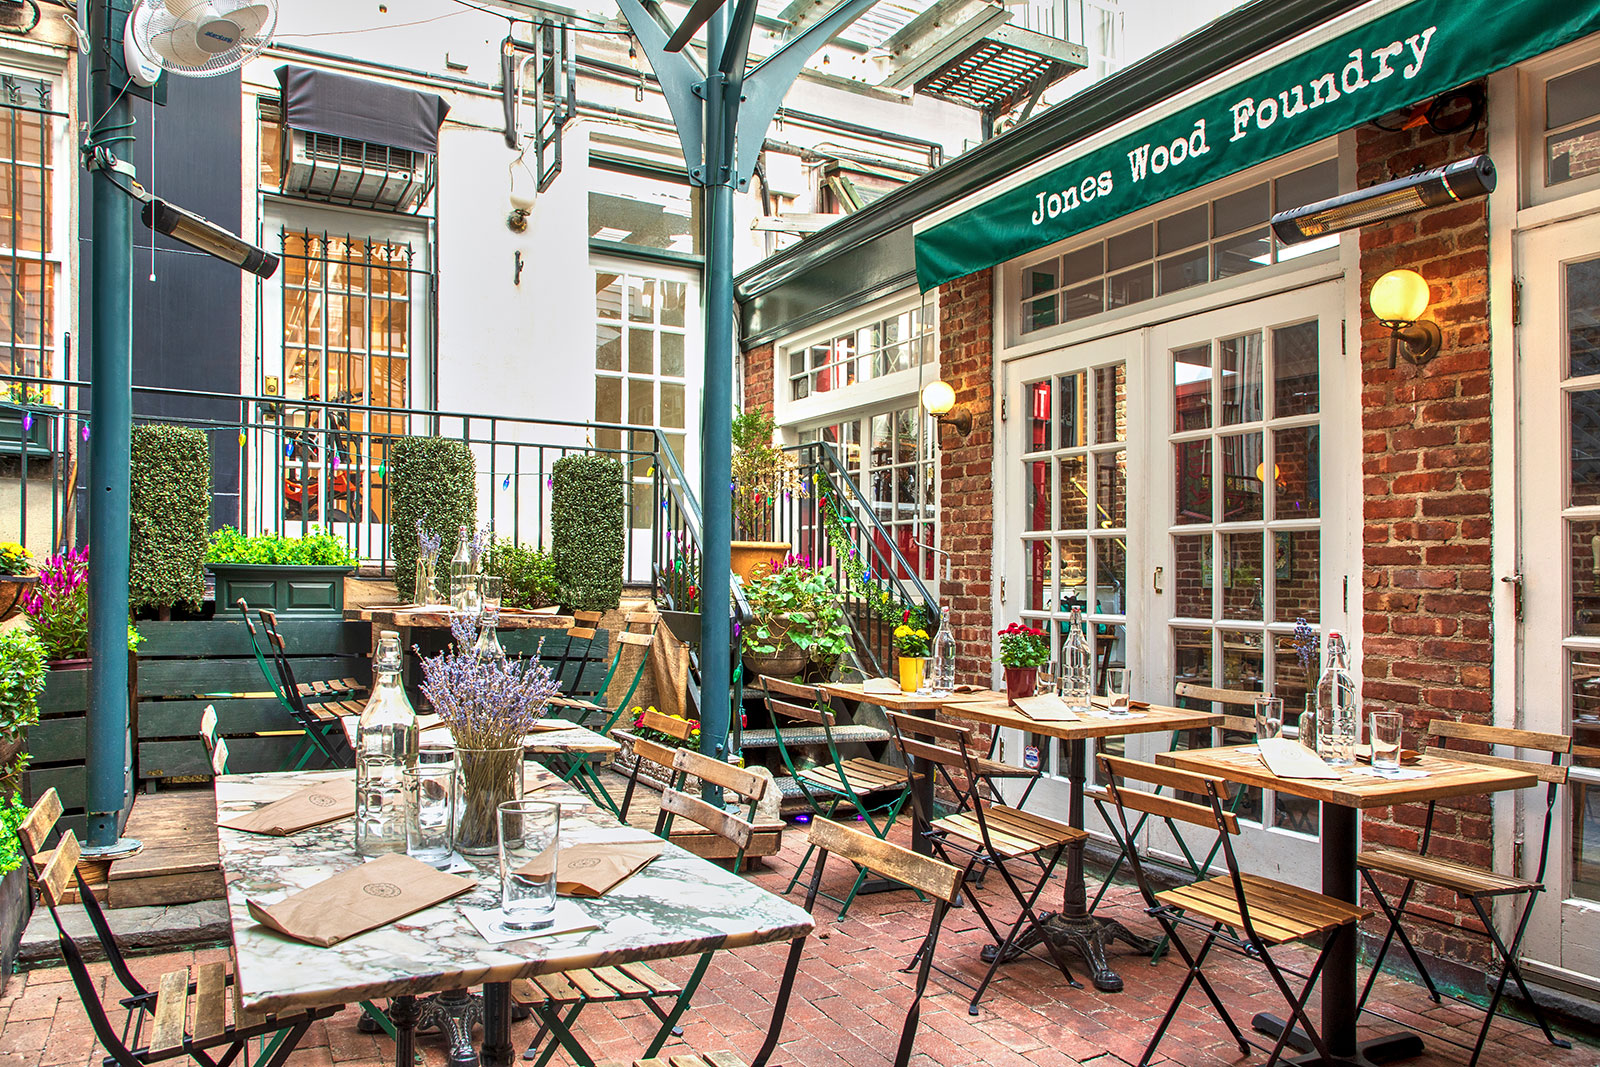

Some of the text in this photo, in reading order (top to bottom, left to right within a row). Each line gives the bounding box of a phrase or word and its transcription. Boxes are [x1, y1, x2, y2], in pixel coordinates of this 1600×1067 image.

[1032, 26, 1438, 226] Jones Wood Foundry
